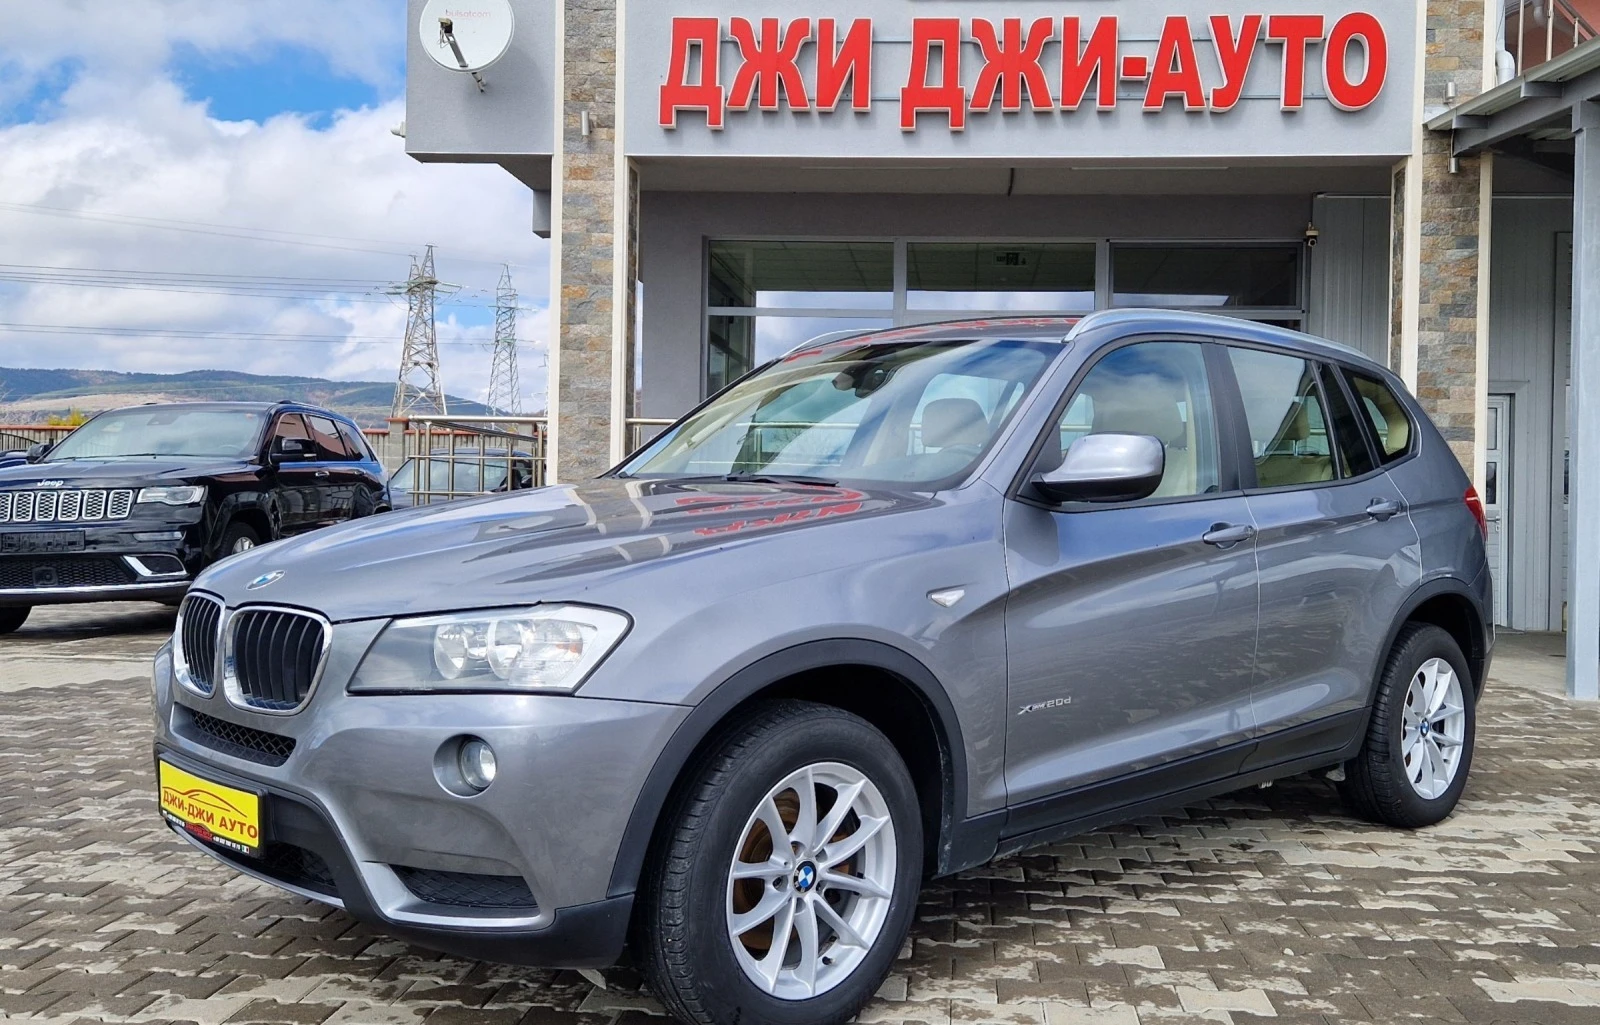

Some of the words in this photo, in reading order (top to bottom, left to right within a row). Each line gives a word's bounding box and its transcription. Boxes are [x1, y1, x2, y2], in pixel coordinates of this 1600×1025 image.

[445, 9, 491, 18] bulsatcom
[658, 16, 873, 129] ДЖИ
[899, 12, 1388, 131] ДЖИ-АУТО
[37, 479, 64, 487] Jeep
[163, 790, 215, 825] ДЖИ-ДЖИ
[219, 816, 258, 839] АУТО
